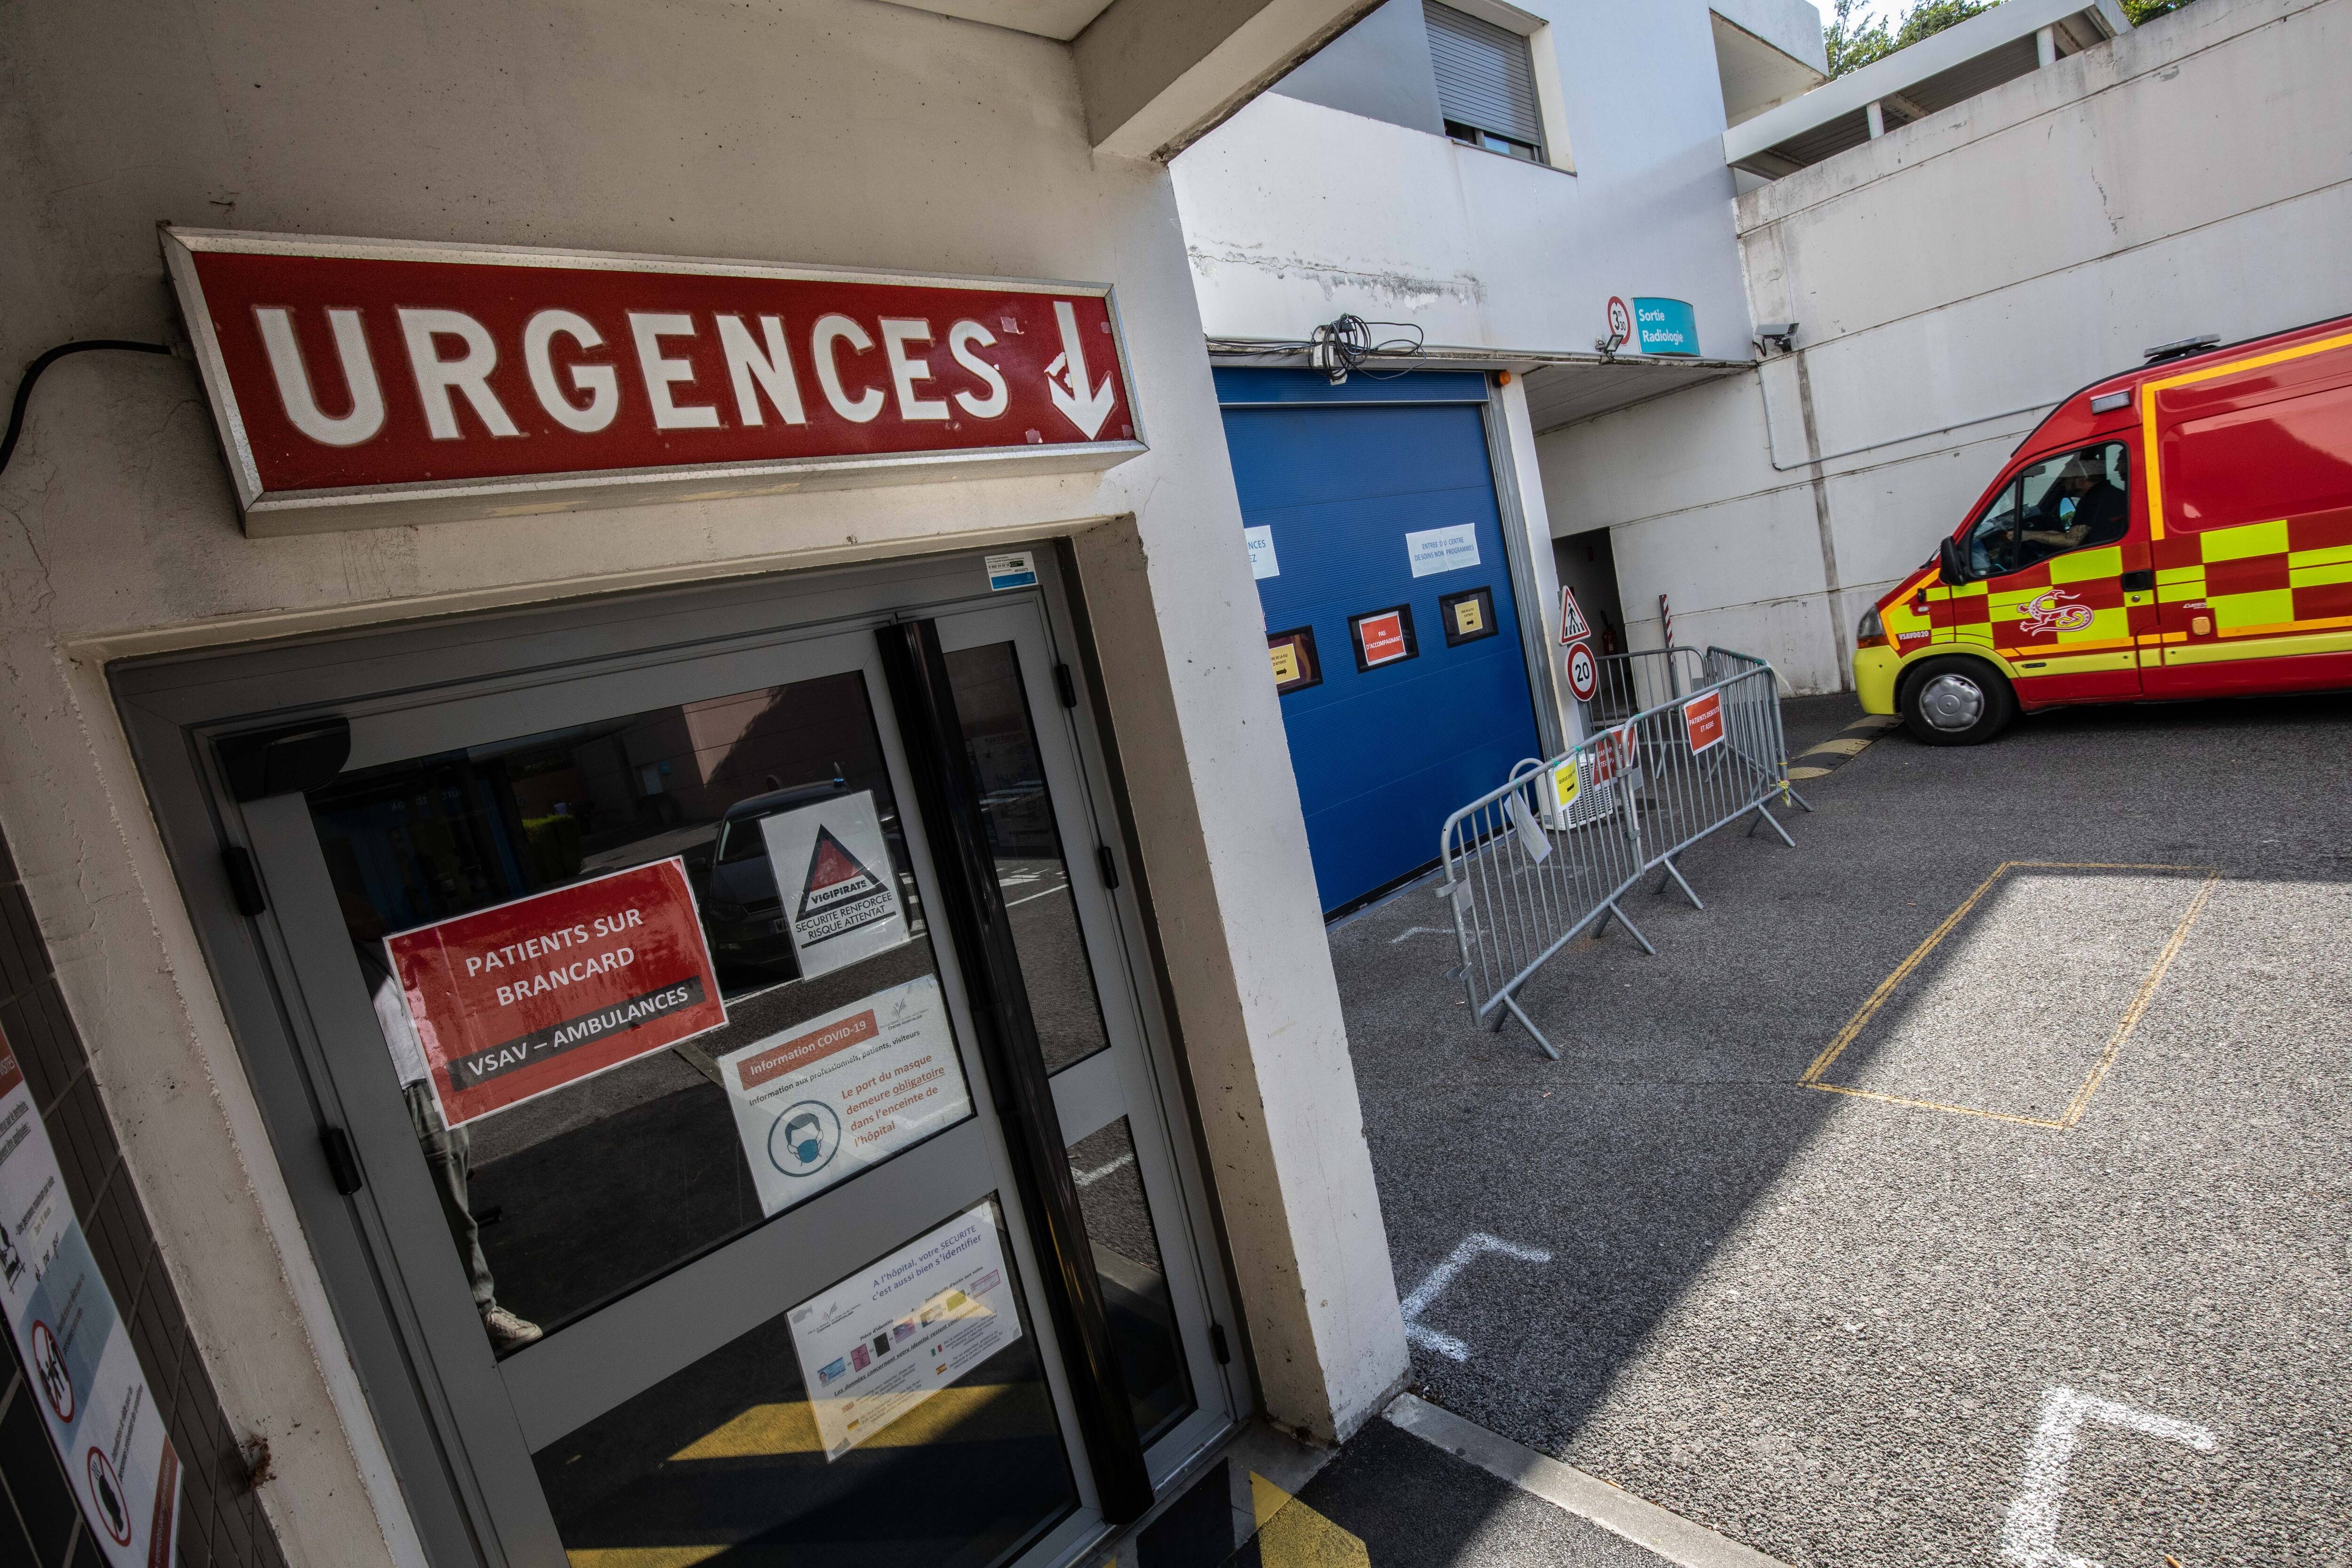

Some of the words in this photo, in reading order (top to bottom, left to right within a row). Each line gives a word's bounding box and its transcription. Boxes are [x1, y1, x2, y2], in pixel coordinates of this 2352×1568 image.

[1638, 309, 1665, 321] Sortie
[1642, 329, 1684, 346] Radiologie
[252, 306, 1011, 446] URGENCES
[1248, 540, 1266, 549] NCES
[1446, 544, 1474, 556] PROGRAMMES
[1449, 537, 1464, 545] CENTRE
[1366, 636, 1401, 650] D'ACCOMPAGNANT
[1575, 661, 1590, 684] 20
[1689, 713, 1707, 726] PATIENTS
[1707, 706, 1720, 718] DEBOUTS
[1705, 720, 1714, 730] ASSIS
[1558, 776, 1568, 784] QUEUE
[811, 879, 867, 904] VIGIPIRATE
[795, 911, 839, 933] SECURITE
[841, 892, 893, 917] RENFORCEE
[808, 921, 843, 939] RISQUE
[845, 905, 885, 927] ATTENTAT
[465, 923, 589, 977] PATIENTS
[596, 908, 644, 938] SUR
[495, 947, 635, 1006] BRANCARD
[468, 1043, 528, 1076] VSAV
[552, 986, 689, 1048] AMBULANCES
[749, 1041, 815, 1076] Information
[816, 1020, 867, 1048] COVID-19
[749, 1082, 794, 1107] Information
[795, 1076, 808, 1087] aux
[809, 1053, 861, 1082] professionnels,
[861, 1041, 891, 1059] patients,
[892, 1028, 920, 1046] visiteurs
[841, 1087, 853, 1099] Le
[854, 1076, 877, 1095] port
[878, 1069, 892, 1082] du
[894, 1053, 932, 1079] masque
[845, 1087, 890, 1116] demeure
[891, 1063, 945, 1097] obligatoire
[850, 1113, 874, 1131] dans
[875, 1089, 923, 1121] l'enceinte
[925, 1083, 938, 1097] de
[854, 1120, 896, 1150] l'hôpital
[871, 1283, 891, 1301] c'est
[893, 1271, 914, 1289] aussi
[915, 1259, 933, 1276] bien
[934, 1232, 981, 1266] s'identifier
[872, 1279, 879, 1288] A
[881, 1257, 917, 1285] l'hôpital,
[918, 1246, 938, 1263] votre
[940, 1224, 976, 1250] SECURITE
[924, 1285, 948, 1303] Justificatifs
[972, 1265, 983, 1275] soins
[860, 1330, 872, 1341] Pièce
[834, 1387, 843, 1396] Les
[844, 1373, 866, 1390] données
[866, 1355, 896, 1377] concernant
[896, 1347, 910, 1358] votre
[910, 1334, 930, 1350] identité
[930, 1323, 947, 1338] restent
